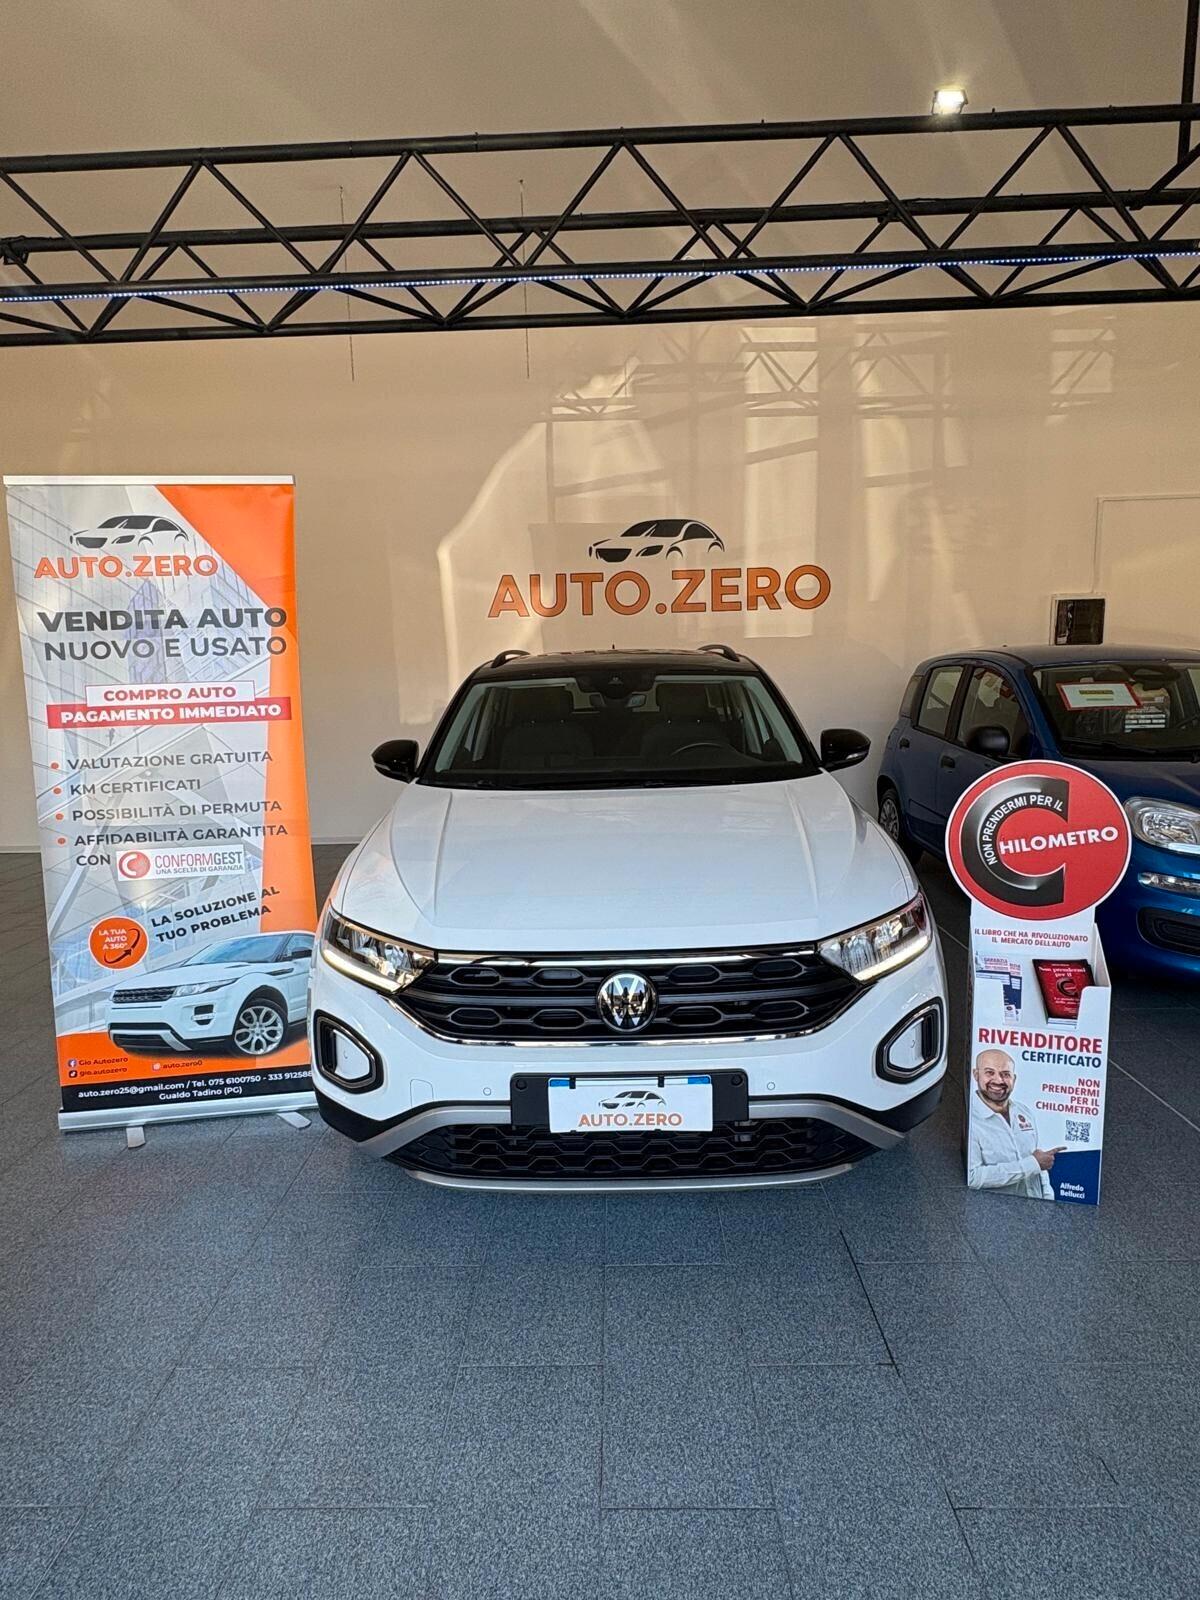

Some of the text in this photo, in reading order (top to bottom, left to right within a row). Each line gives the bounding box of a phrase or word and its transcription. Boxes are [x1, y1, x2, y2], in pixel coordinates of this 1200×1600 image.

[34, 554, 218, 579] AUTO.ZERO
[487, 564, 831, 618] AUTO.ZERO
[37, 607, 287, 632] VENDITA AUTO
[44, 636, 287, 661] NUOVO E USATO
[103, 686, 236, 701] COMPRO AUTO
[60, 704, 282, 724] PAGAMENTO IMMEDIATO
[67, 751, 273, 770] VALUTAZIONE GRATUITA
[70, 779, 200, 795] KM CERTIFICATI
[72, 801, 282, 821] POSSIBILITÀ DI PERMUTA
[74, 825, 288, 846] AFFIDABILITÀ GARANTITA
[982, 794, 1063, 866] NON PRENDERMI PER IL
[76, 854, 111, 867] CON
[154, 851, 243, 868] CONFORMGEST
[209, 865, 244, 873] GARANZIA
[151, 886, 280, 928] LA SOLUZIONE AL
[156, 905, 271, 943] TUO PROBLEMA
[105, 935, 127, 943] AUTO
[1001, 937, 1033, 945] MERCATO
[1034, 939, 1071, 948] DELL'AUTO
[1031, 932, 1088, 942] RIVOLUZIONATO
[978, 1028, 1103, 1054] RIVENDITORE
[93, 1057, 129, 1066] Autozero
[1022, 1050, 1102, 1068] CERTIFICATO
[79, 1067, 128, 1077] gio.autozero
[78, 1082, 185, 1098] auto.zero25@gmail.com
[192, 1079, 207, 1087] Tel.
[226, 1075, 261, 1085] 6100750
[268, 1073, 283, 1081] 333
[1042, 1084, 1100, 1097] PRENDERMI
[1078, 1078, 1100, 1088] NON
[159, 1086, 243, 1100] Gualdo Tadino (PG)
[1036, 1101, 1099, 1116] CHILOMETRO
[1070, 1096, 1100, 1106] PER IL
[578, 1113, 682, 1127] AUTO.ZERO
[1060, 1182, 1084, 1192] Alfredo
[1060, 1189, 1085, 1199] Bellucci
